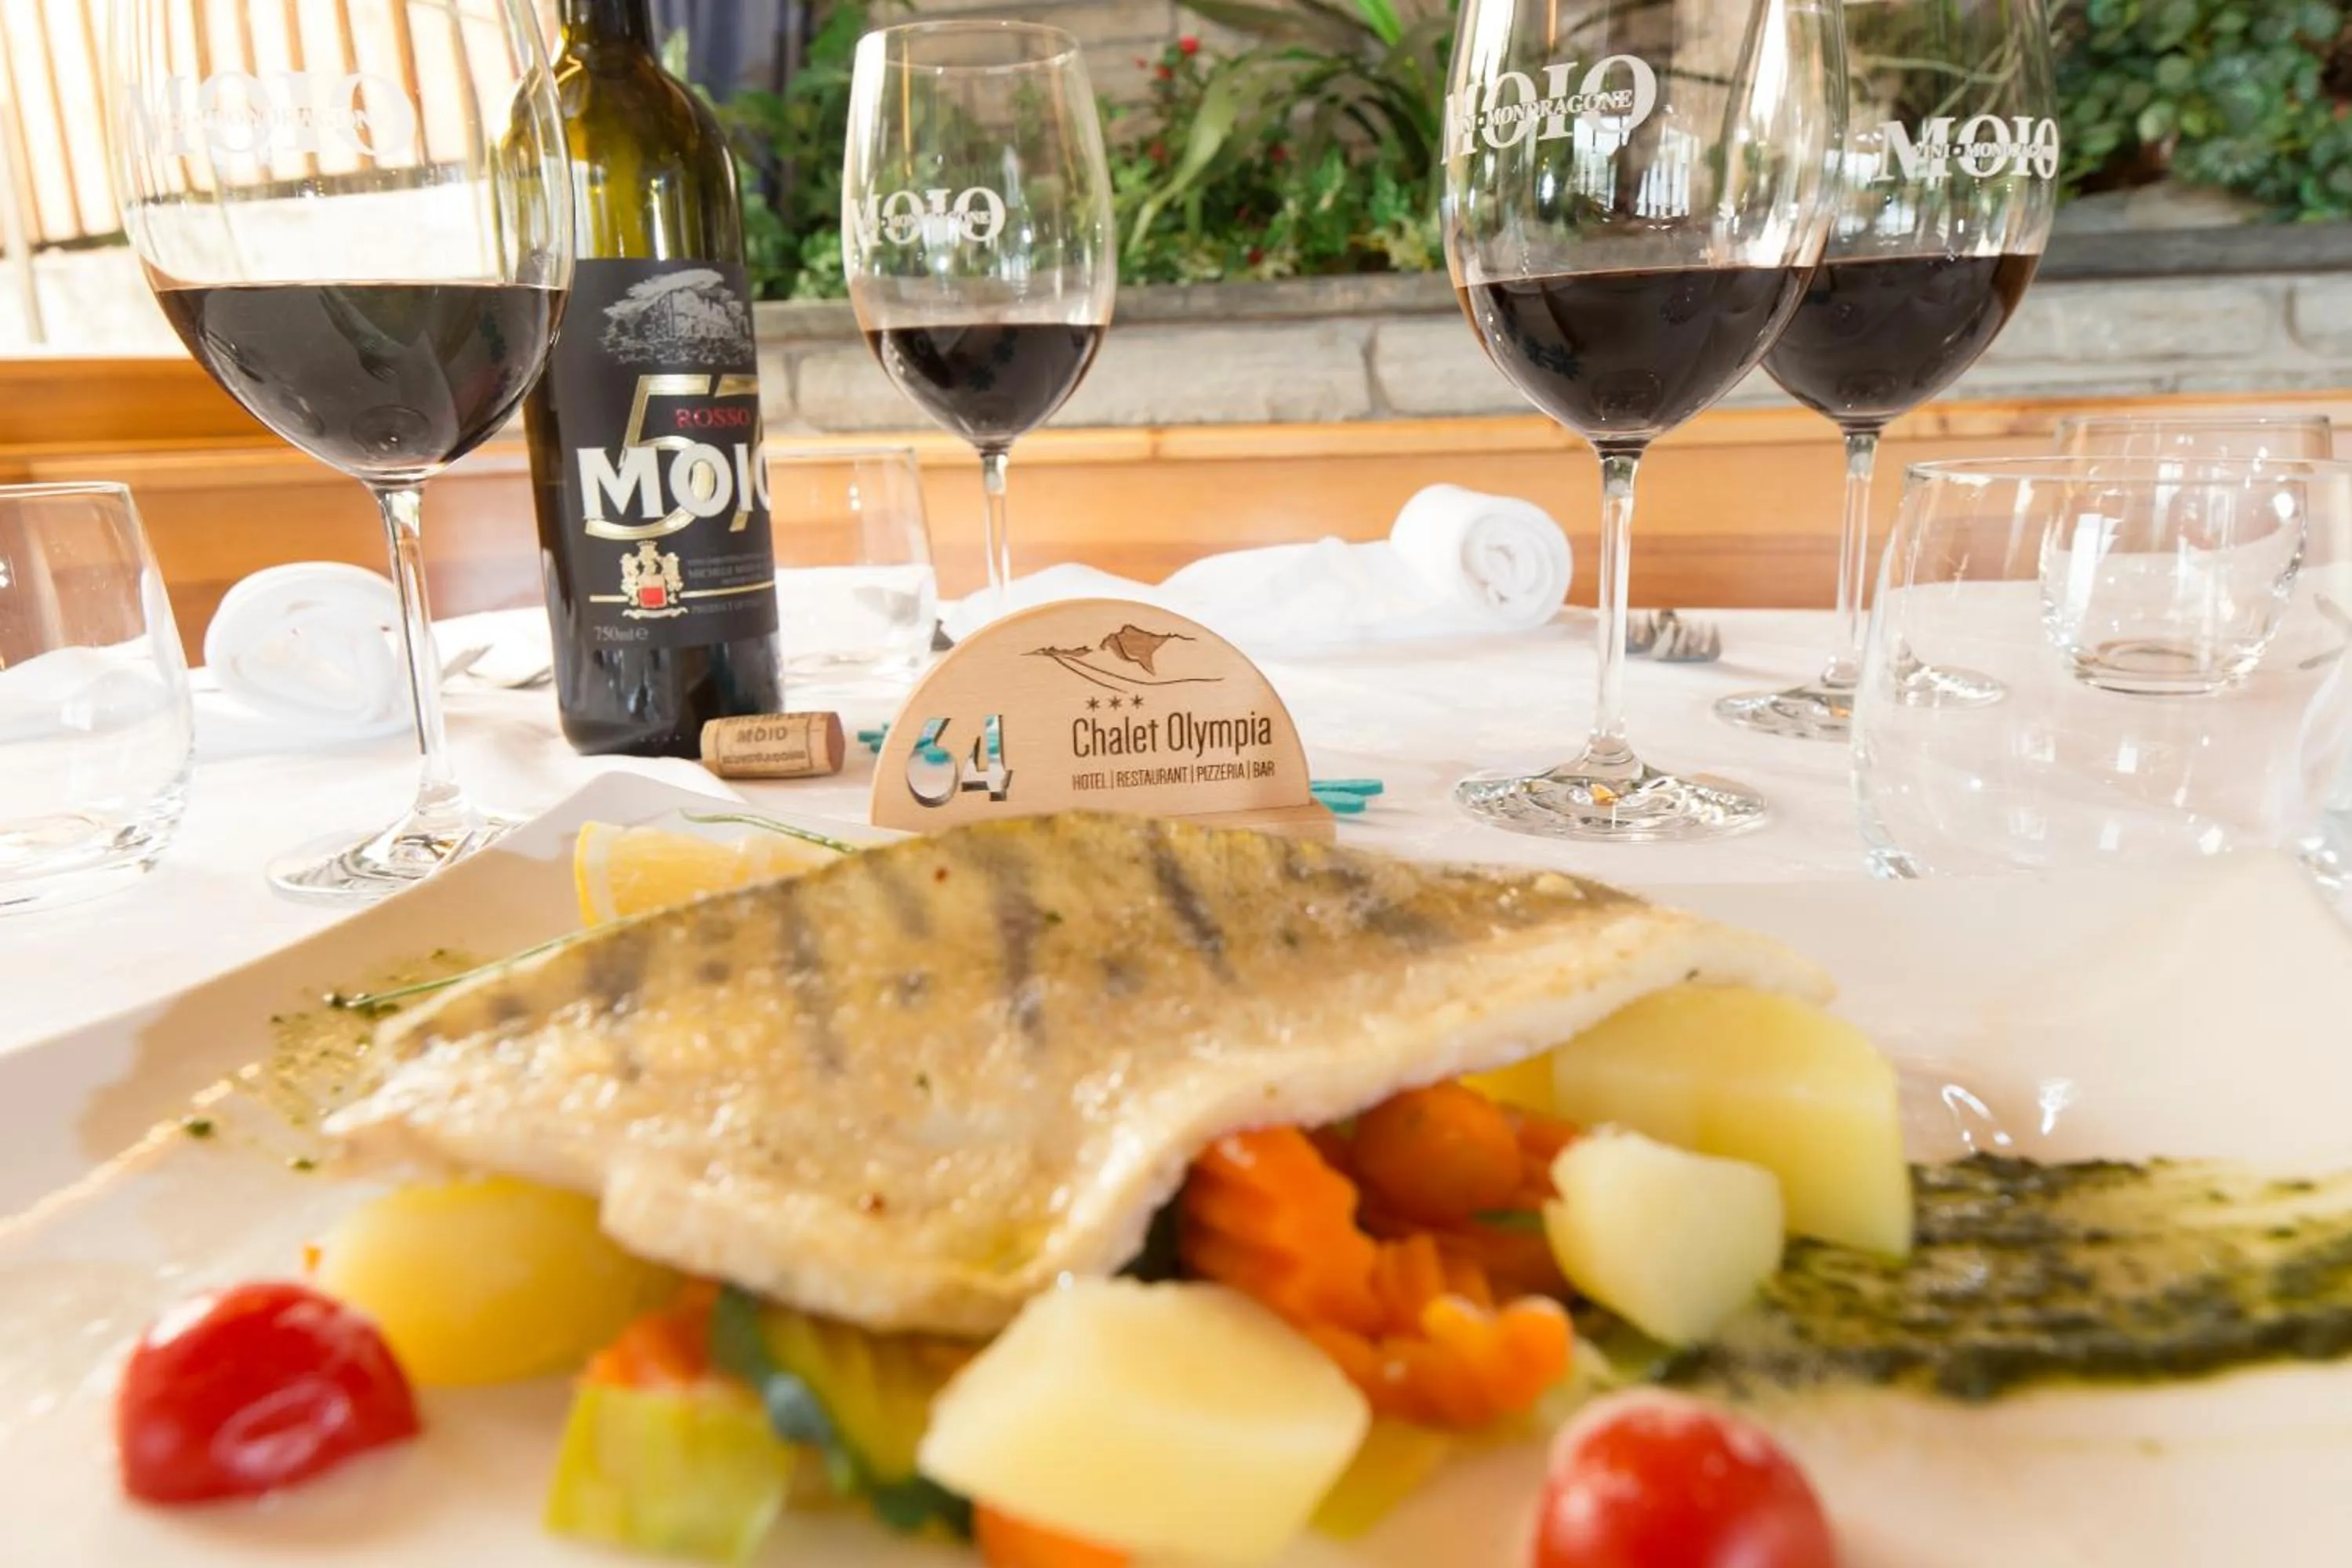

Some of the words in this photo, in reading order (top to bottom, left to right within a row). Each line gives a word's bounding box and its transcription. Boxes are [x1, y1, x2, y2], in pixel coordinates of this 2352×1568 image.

[126, 70, 417, 156] MOIO
[1441, 54, 1657, 165] MOIO
[1488, 89, 1633, 127] MONDRAGONE
[1872, 114, 2059, 182] MOIO
[851, 187, 1006, 253] MOIO
[675, 408, 751, 428] ROSSO
[593, 625, 634, 641] 750ml
[735, 726, 788, 743] MOIO
[1072, 715, 1159, 758] Chalet
[1167, 711, 1272, 758] Olympia
[906, 714, 1014, 808] 64
[1072, 772, 1107, 790] HOTEL
[1116, 766, 1189, 788] RESTAURANT
[1196, 762, 1245, 782] PIZZERIA
[1253, 760, 1276, 779] BAR
